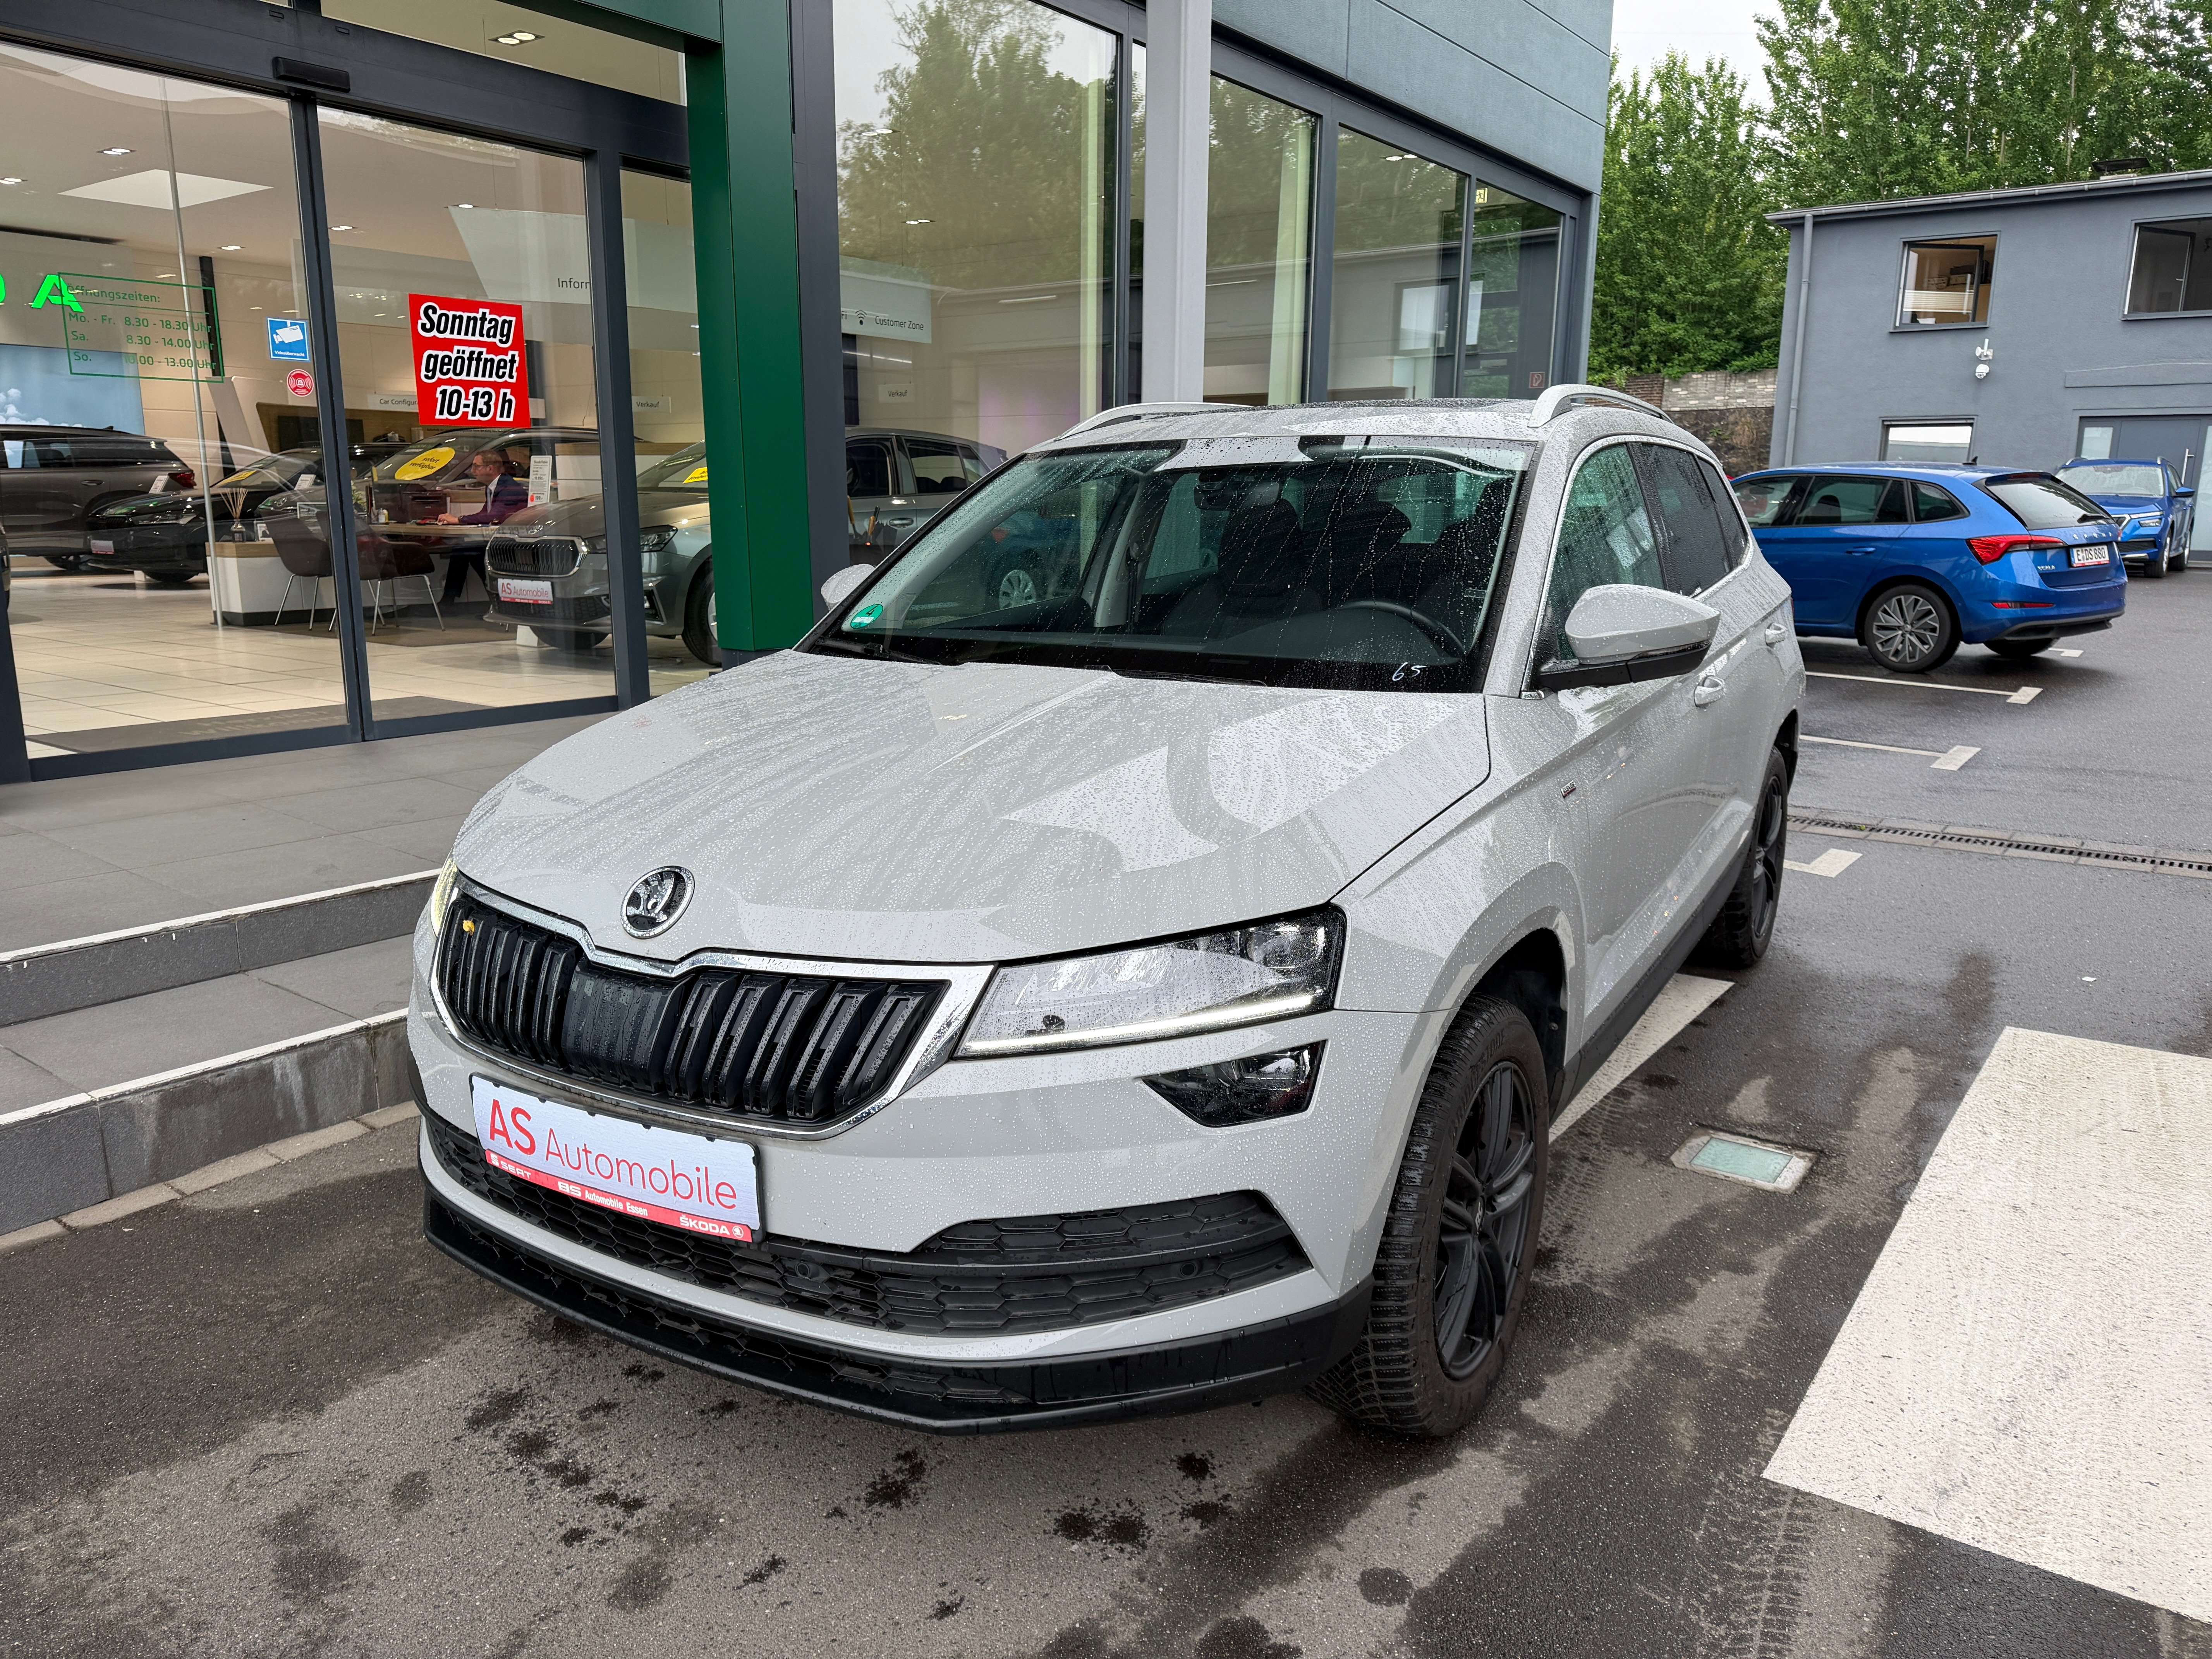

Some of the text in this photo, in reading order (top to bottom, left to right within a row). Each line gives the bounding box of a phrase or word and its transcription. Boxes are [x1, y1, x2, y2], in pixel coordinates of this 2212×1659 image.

[69, 313, 89, 323] Mo.
[101, 315, 115, 325] Fr.
[124, 317, 149, 327] 8.30
[160, 320, 188, 330] 18.30
[193, 322, 211, 332] Uhr
[419, 303, 514, 346] Sonntag
[875, 316, 924, 330] Customer Zone
[72, 331, 88, 341] Sa.
[127, 335, 151, 345] 8.30
[161, 338, 191, 348] 14.00
[195, 340, 214, 350] Uhr
[74, 352, 91, 361] So.
[124, 354, 154, 365] 10.00
[165, 357, 193, 368] 13.00
[197, 359, 216, 369] Uhr
[422, 348, 518, 381] geöffnet
[437, 387, 514, 419] 10-13 h
[2076, 549, 2081, 562] E
[501, 582, 549, 598] AS Automobile
[866, 605, 878, 616] 4
[489, 1099, 737, 1209] AS Automobile
[501, 1160, 531, 1180] SEAT
[585, 1189, 623, 1210] Automobile
[626, 1202, 648, 1216] Essen
[679, 1214, 730, 1235] ŠKODA
